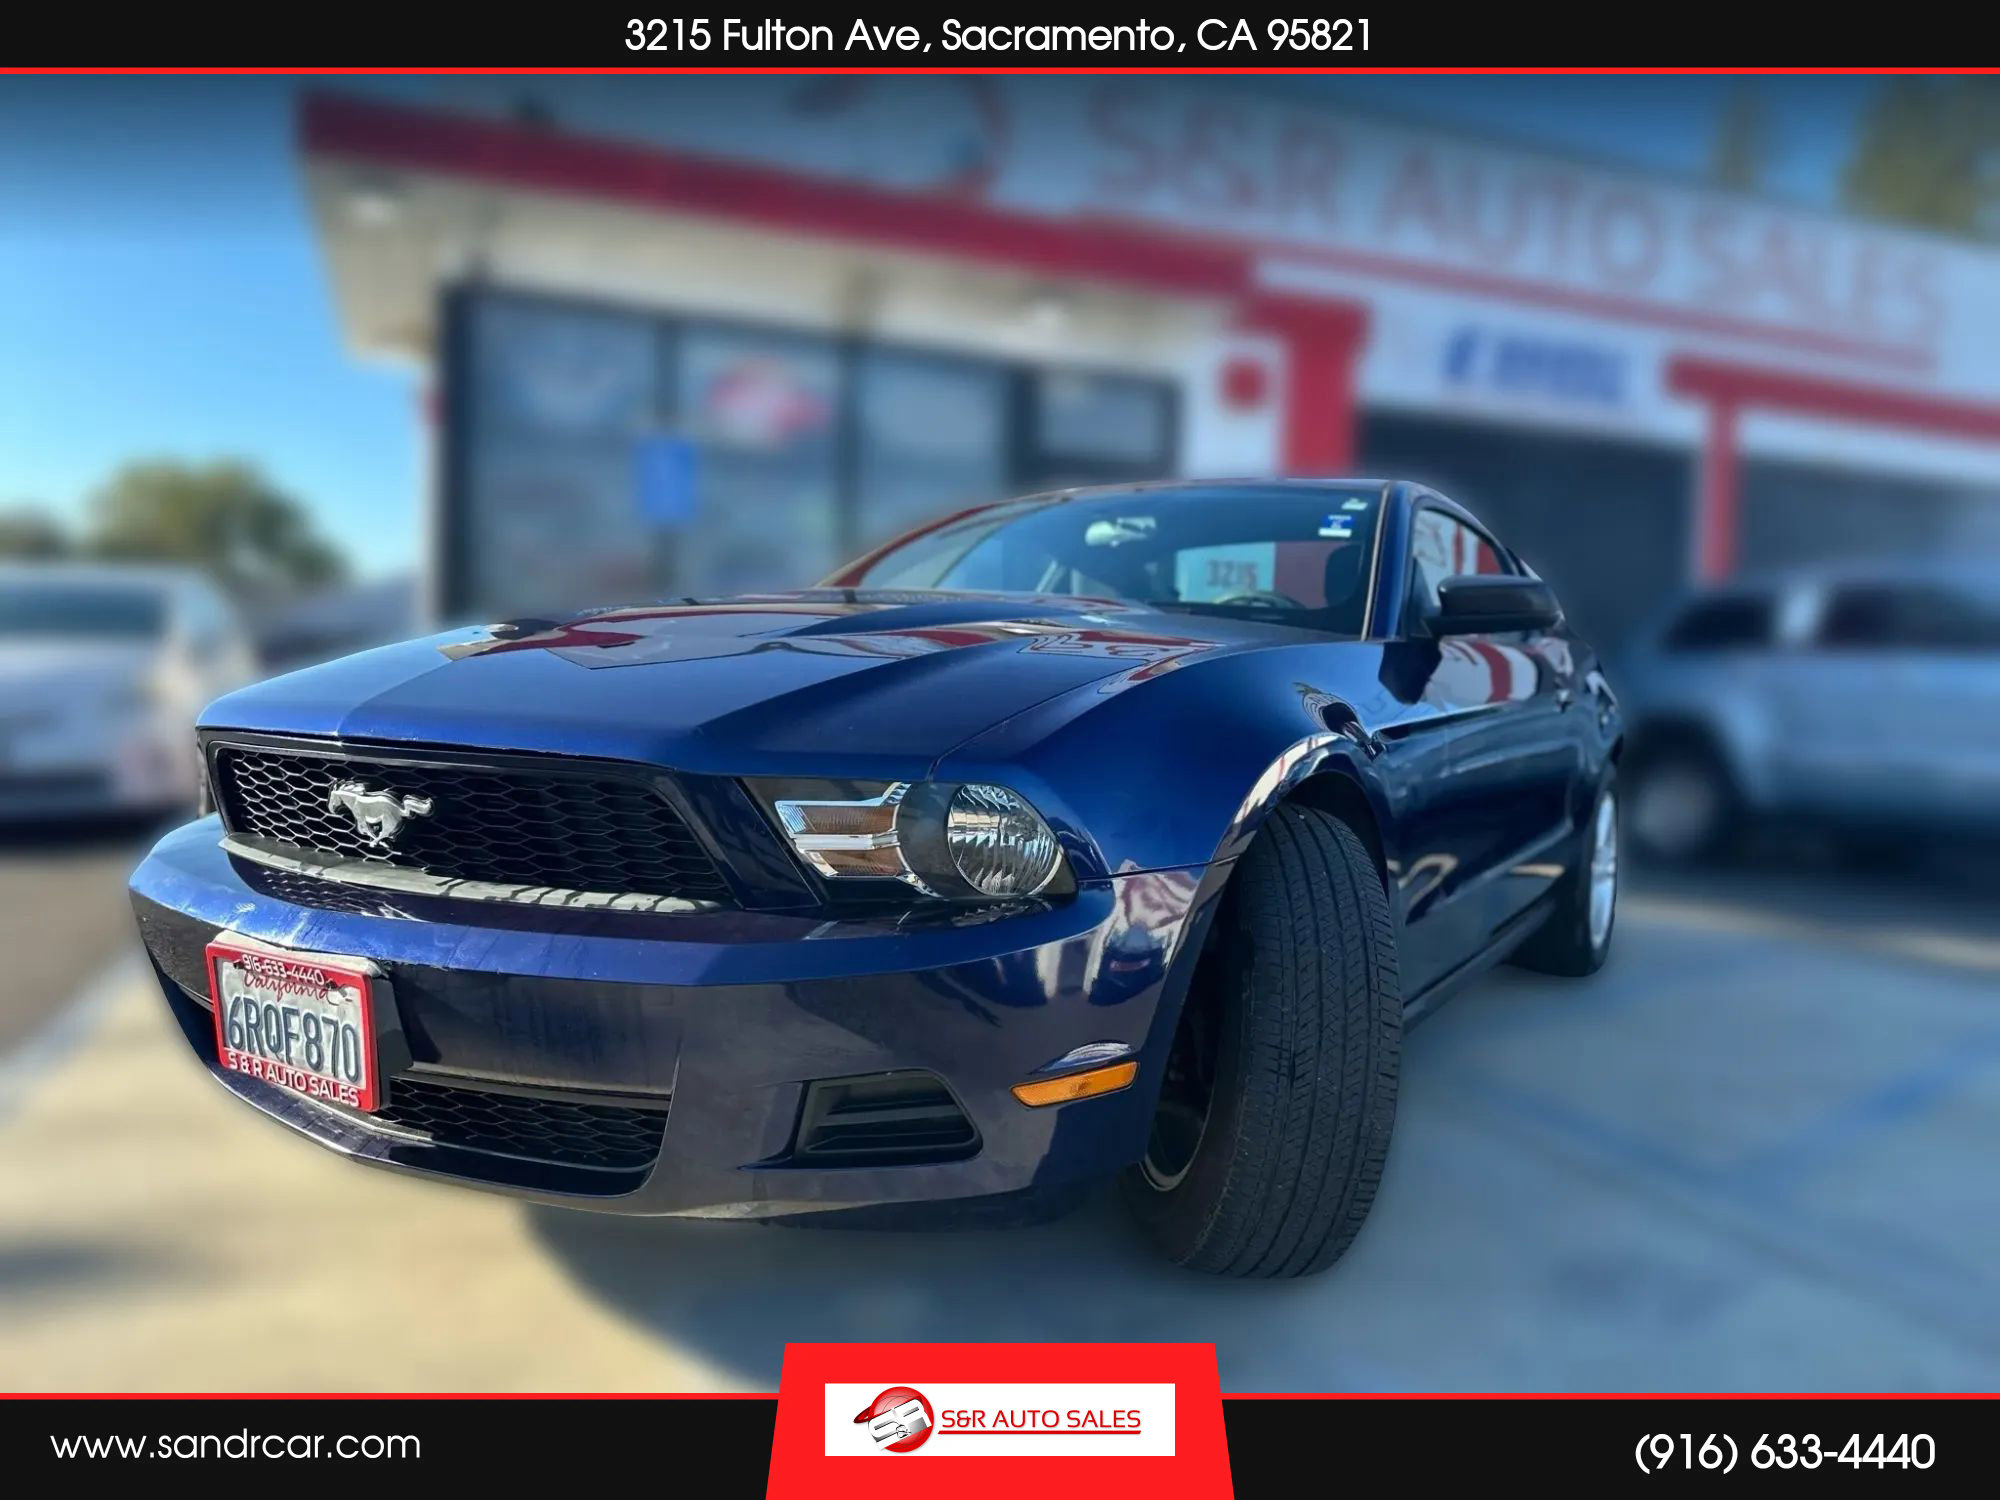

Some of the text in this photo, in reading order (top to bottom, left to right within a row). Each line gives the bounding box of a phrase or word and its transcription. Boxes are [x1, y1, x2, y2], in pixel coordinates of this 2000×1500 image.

[1379, 142, 1665, 284] AUTO
[1692, 203, 1937, 333] SALES
[241, 953, 326, 986] 916-633-4440
[228, 995, 362, 1084] 6RQF870
[266, 1064, 308, 1092] AUTO
[310, 1076, 360, 1108] SALES
